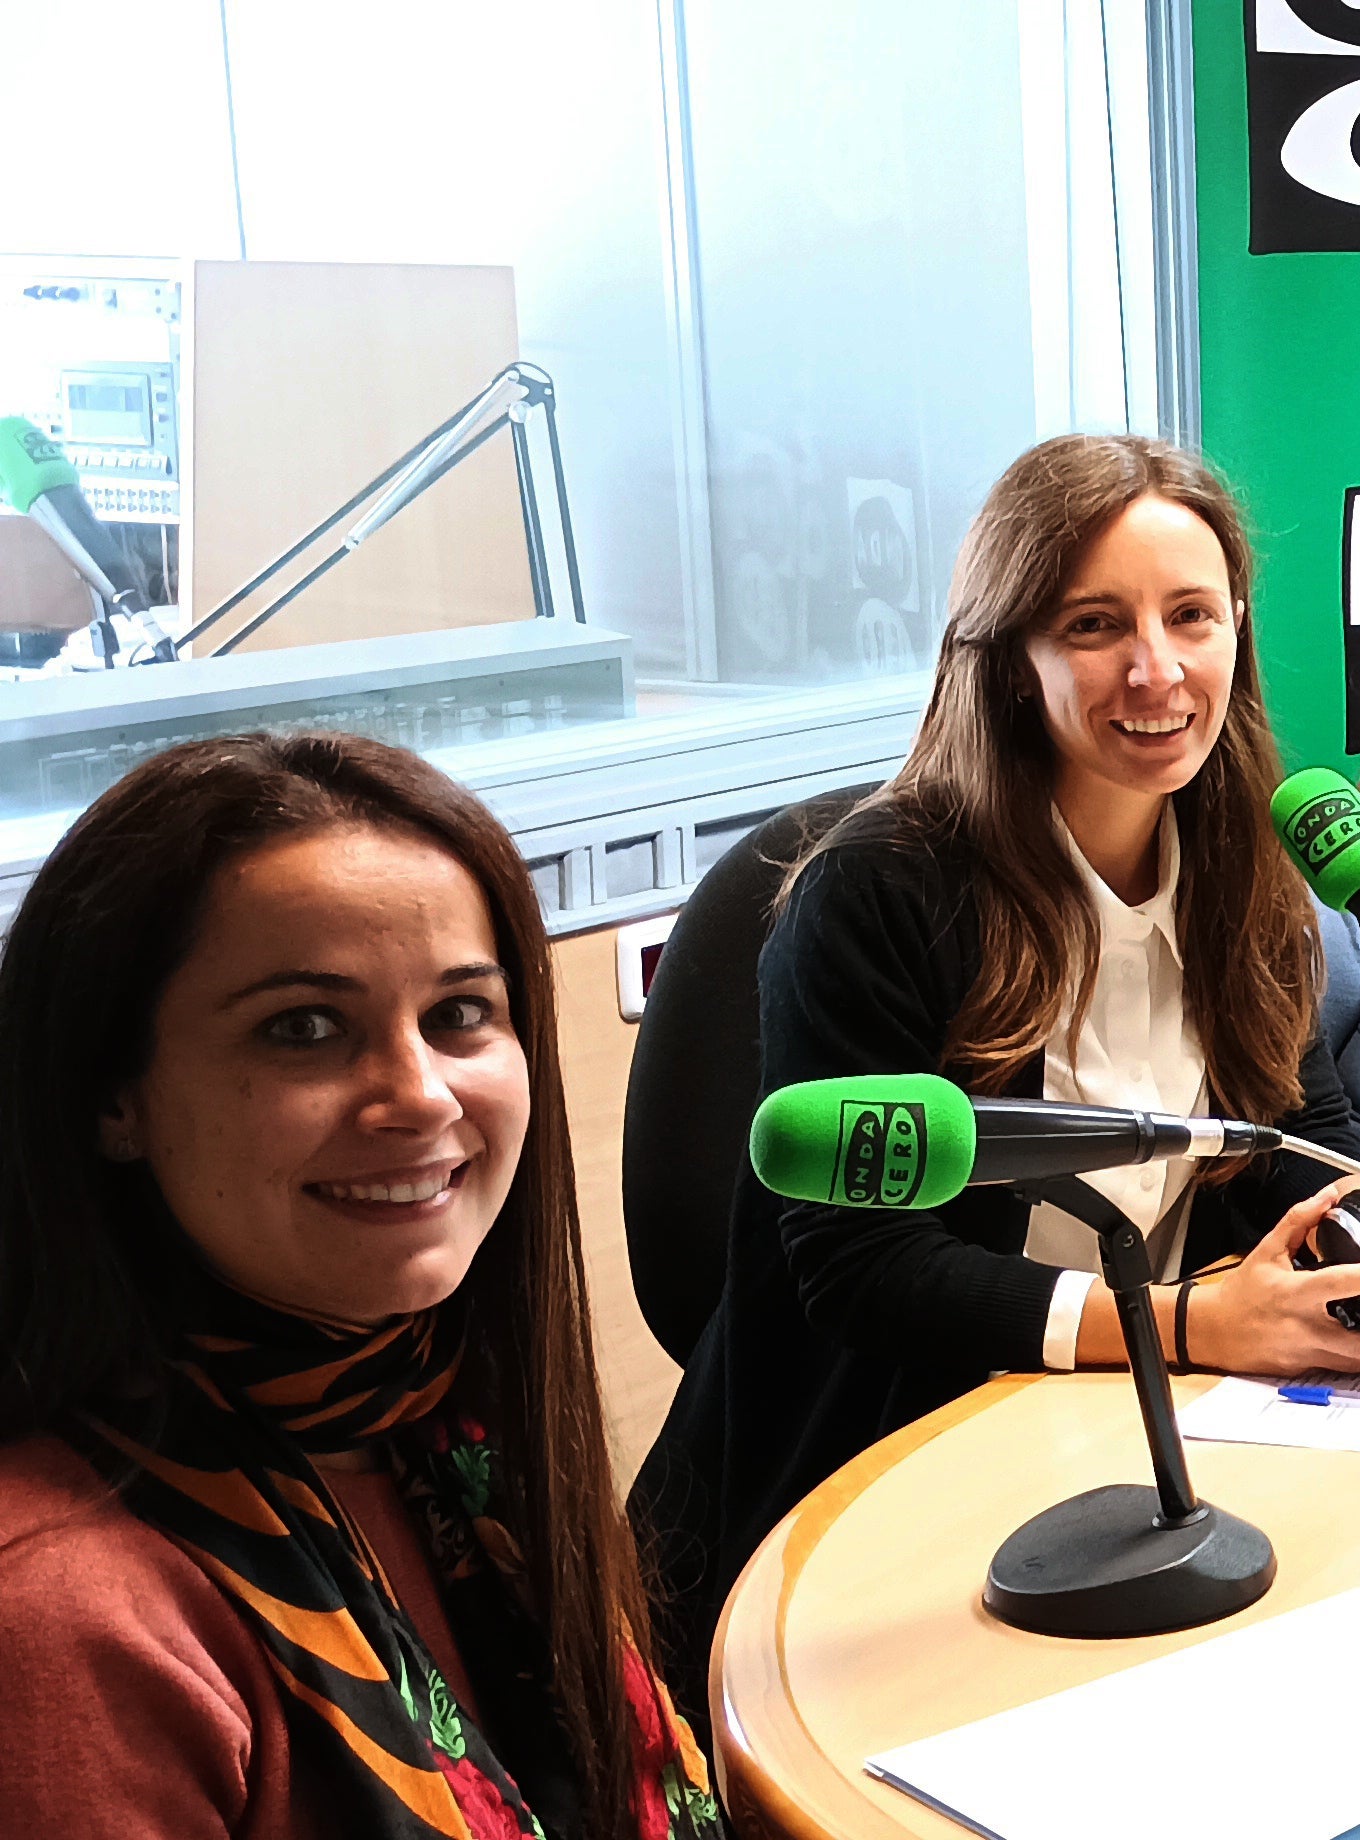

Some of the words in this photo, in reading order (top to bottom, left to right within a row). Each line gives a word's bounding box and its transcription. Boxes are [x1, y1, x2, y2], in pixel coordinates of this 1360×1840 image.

[1296, 800, 1352, 838] ONDA
[849, 1120, 875, 1199] ONDA
[884, 1120, 912, 1198] CERO
